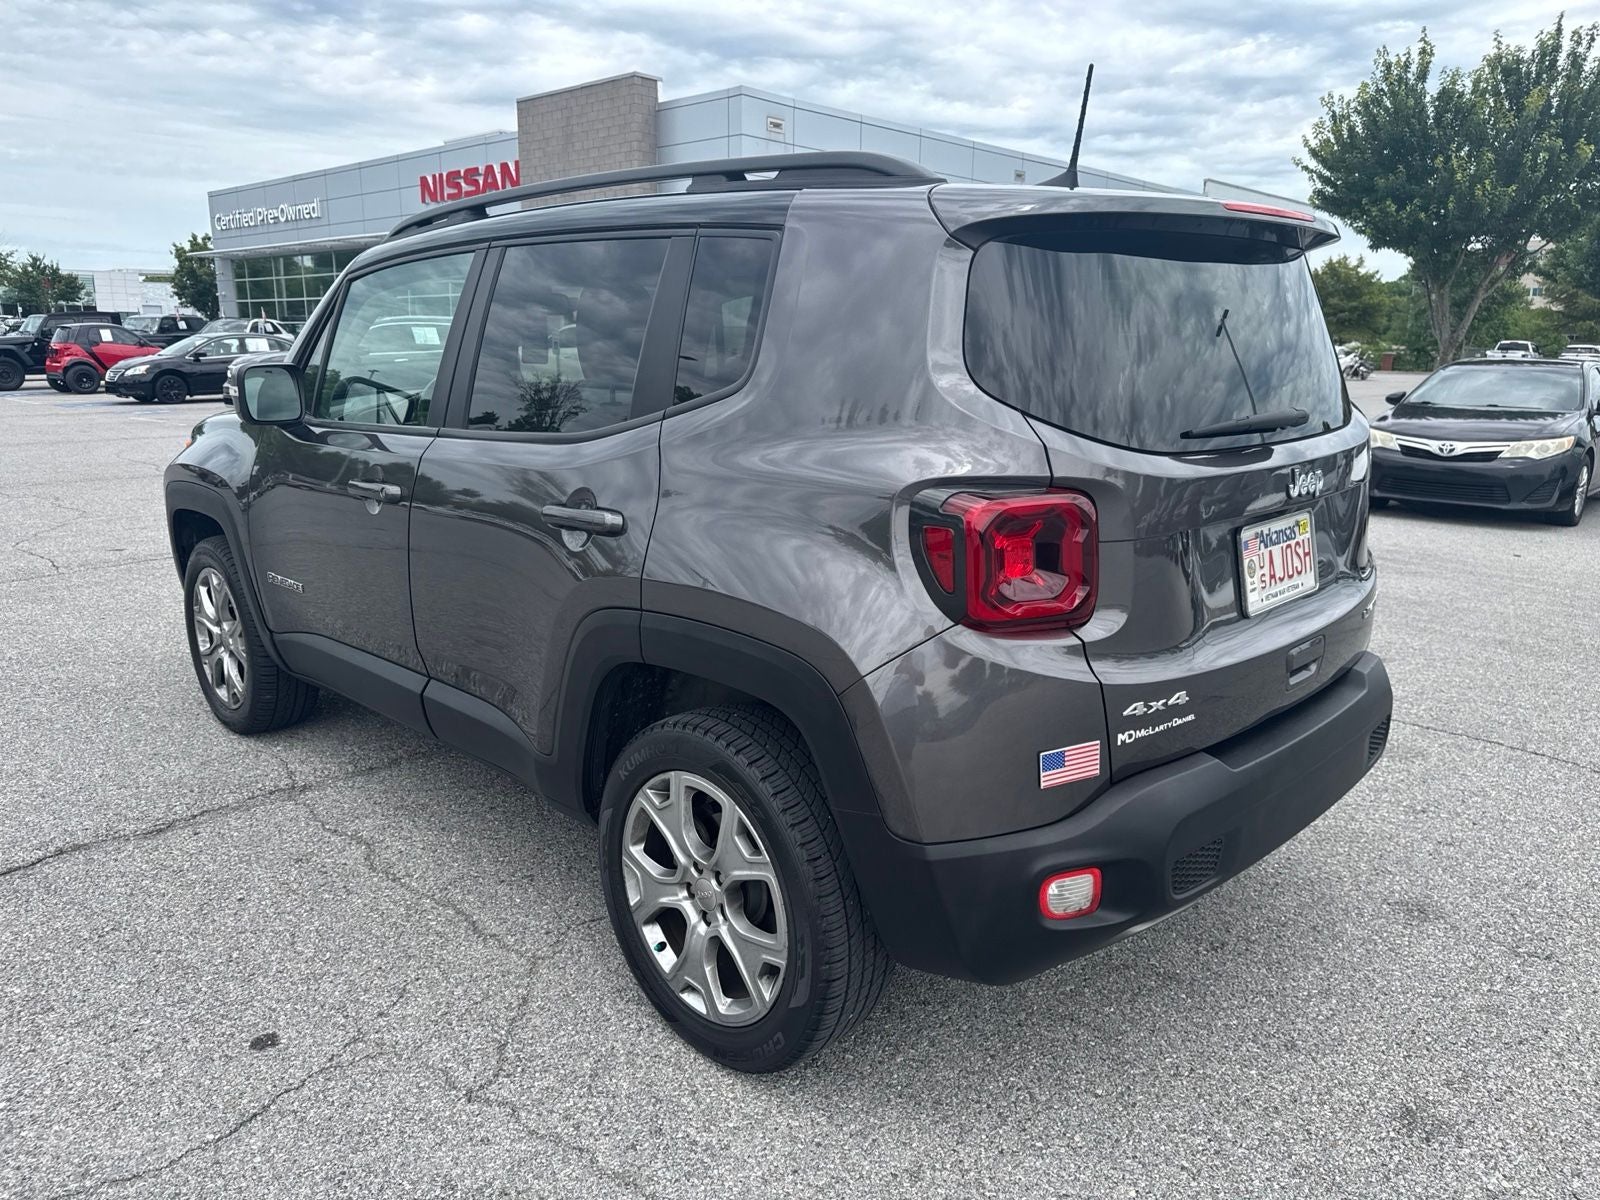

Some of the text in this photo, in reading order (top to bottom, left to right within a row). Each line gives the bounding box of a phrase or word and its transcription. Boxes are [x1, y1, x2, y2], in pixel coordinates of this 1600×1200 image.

[419, 160, 519, 203] NISSAN
[214, 197, 321, 231] Certified Pre-Owned
[1288, 468, 1324, 497] Jeep
[1259, 525, 1297, 550] Arkansas
[1268, 537, 1313, 588] AJOSH
[1122, 690, 1190, 716] 4x4
[618, 743, 665, 782] KUMHO
